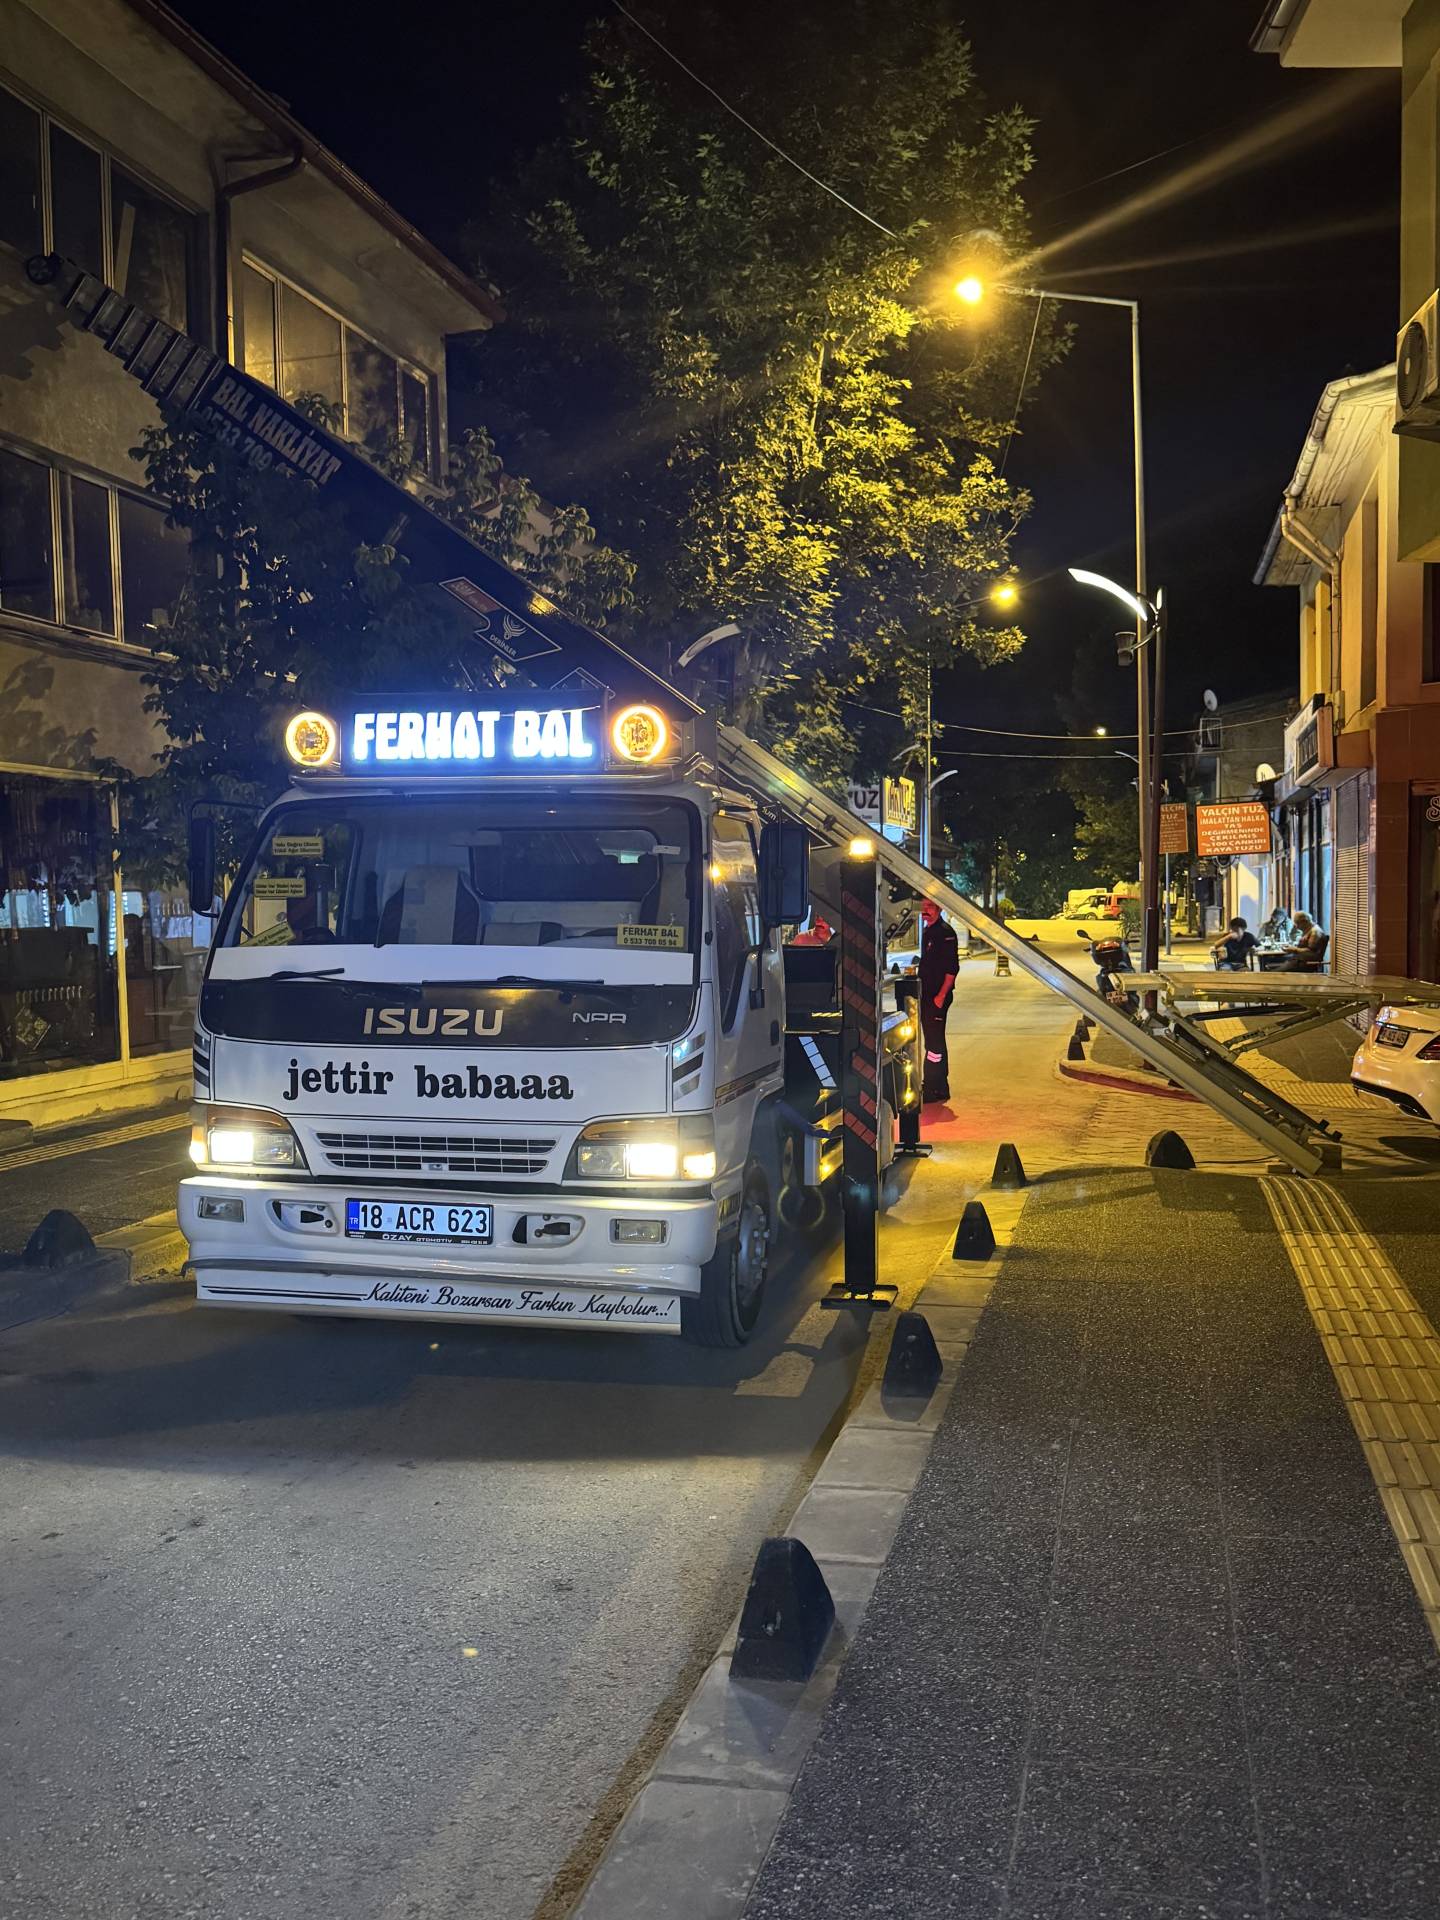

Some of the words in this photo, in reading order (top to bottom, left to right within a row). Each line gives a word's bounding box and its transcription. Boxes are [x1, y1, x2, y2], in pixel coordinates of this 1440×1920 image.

[212, 376, 254, 422] BAL
[248, 402, 343, 485] NAKLİYAT
[353, 711, 500, 760] FERHAT
[513, 709, 593, 758] BAL
[848, 790, 879, 809] UZ
[1202, 807, 1240, 816] YALÇIN
[1242, 805, 1264, 813] TUZ
[623, 927, 658, 937] FERHAT
[661, 928, 679, 937] BAL
[363, 1008, 503, 1036] ISUZU
[282, 1058, 394, 1101] jettir
[414, 1065, 574, 1100] babaaa
[350, 1217, 359, 1225] TR
[361, 1204, 382, 1229] 18
[396, 1207, 435, 1231] ACR
[448, 1208, 487, 1234] 623
[366, 1282, 429, 1305] Kaliteni
[431, 1286, 513, 1310] Bozarsan
[518, 1290, 576, 1313] Farkın
